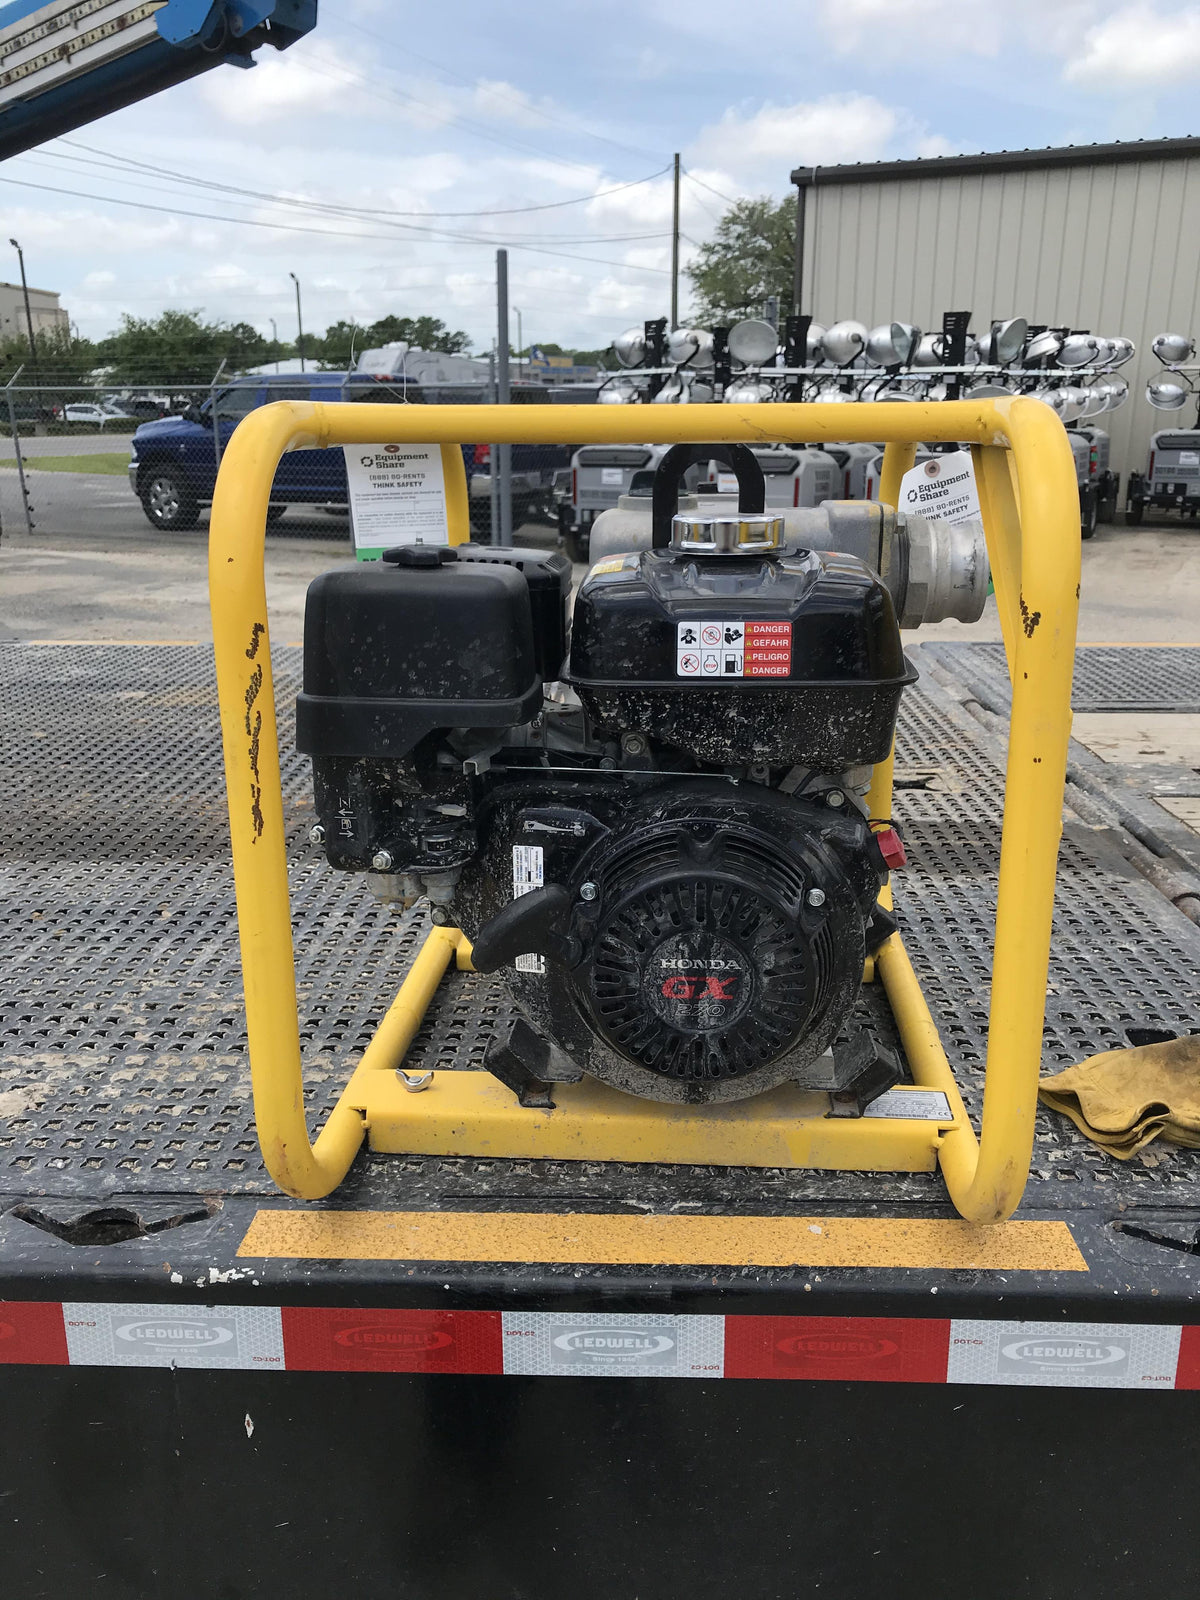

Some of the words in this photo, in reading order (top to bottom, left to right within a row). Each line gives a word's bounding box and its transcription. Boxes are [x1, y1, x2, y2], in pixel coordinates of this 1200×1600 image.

[374, 453, 429, 462] Equipment
[375, 461, 405, 469] Share
[918, 470, 970, 493] Equipment
[919, 488, 950, 503] Share
[936, 495, 970, 511] 80-RENTS
[943, 504, 969, 517] SAFETY
[753, 625, 790, 633] DANGER
[752, 639, 789, 647] GEFAHR
[752, 653, 789, 661] PELIGRO
[752, 666, 789, 675] DANGER
[659, 958, 742, 970] HONDA
[661, 976, 738, 1000] GX
[675, 1003, 726, 1017] 270
[136, 1328, 213, 1340] LEDWELL
[353, 1332, 430, 1344] LEDWELL
[574, 1337, 653, 1349] LEDWELL
[1023, 1346, 1104, 1359] LEDWELL
